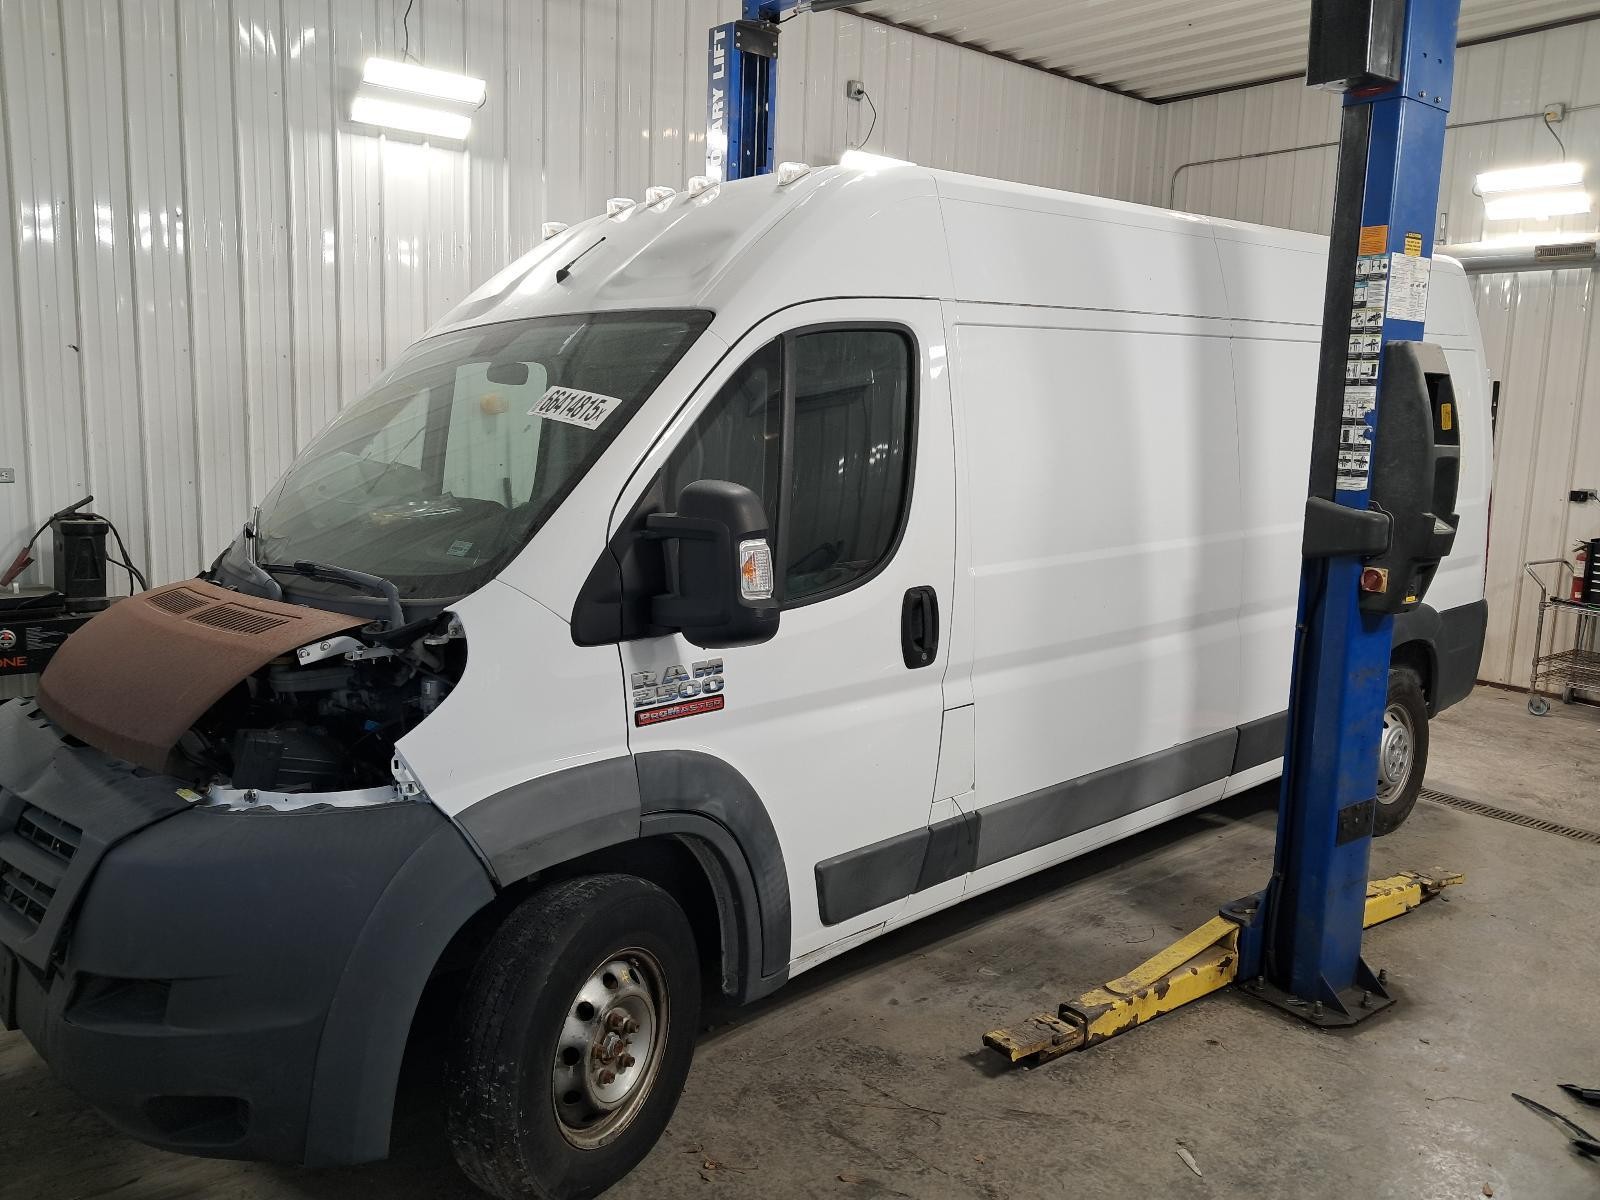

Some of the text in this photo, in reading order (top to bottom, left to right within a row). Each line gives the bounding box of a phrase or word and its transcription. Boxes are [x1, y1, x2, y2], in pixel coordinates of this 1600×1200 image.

[712, 29, 726, 80] LIFT
[631, 658, 724, 690] RAM
[633, 675, 725, 708] 2500
